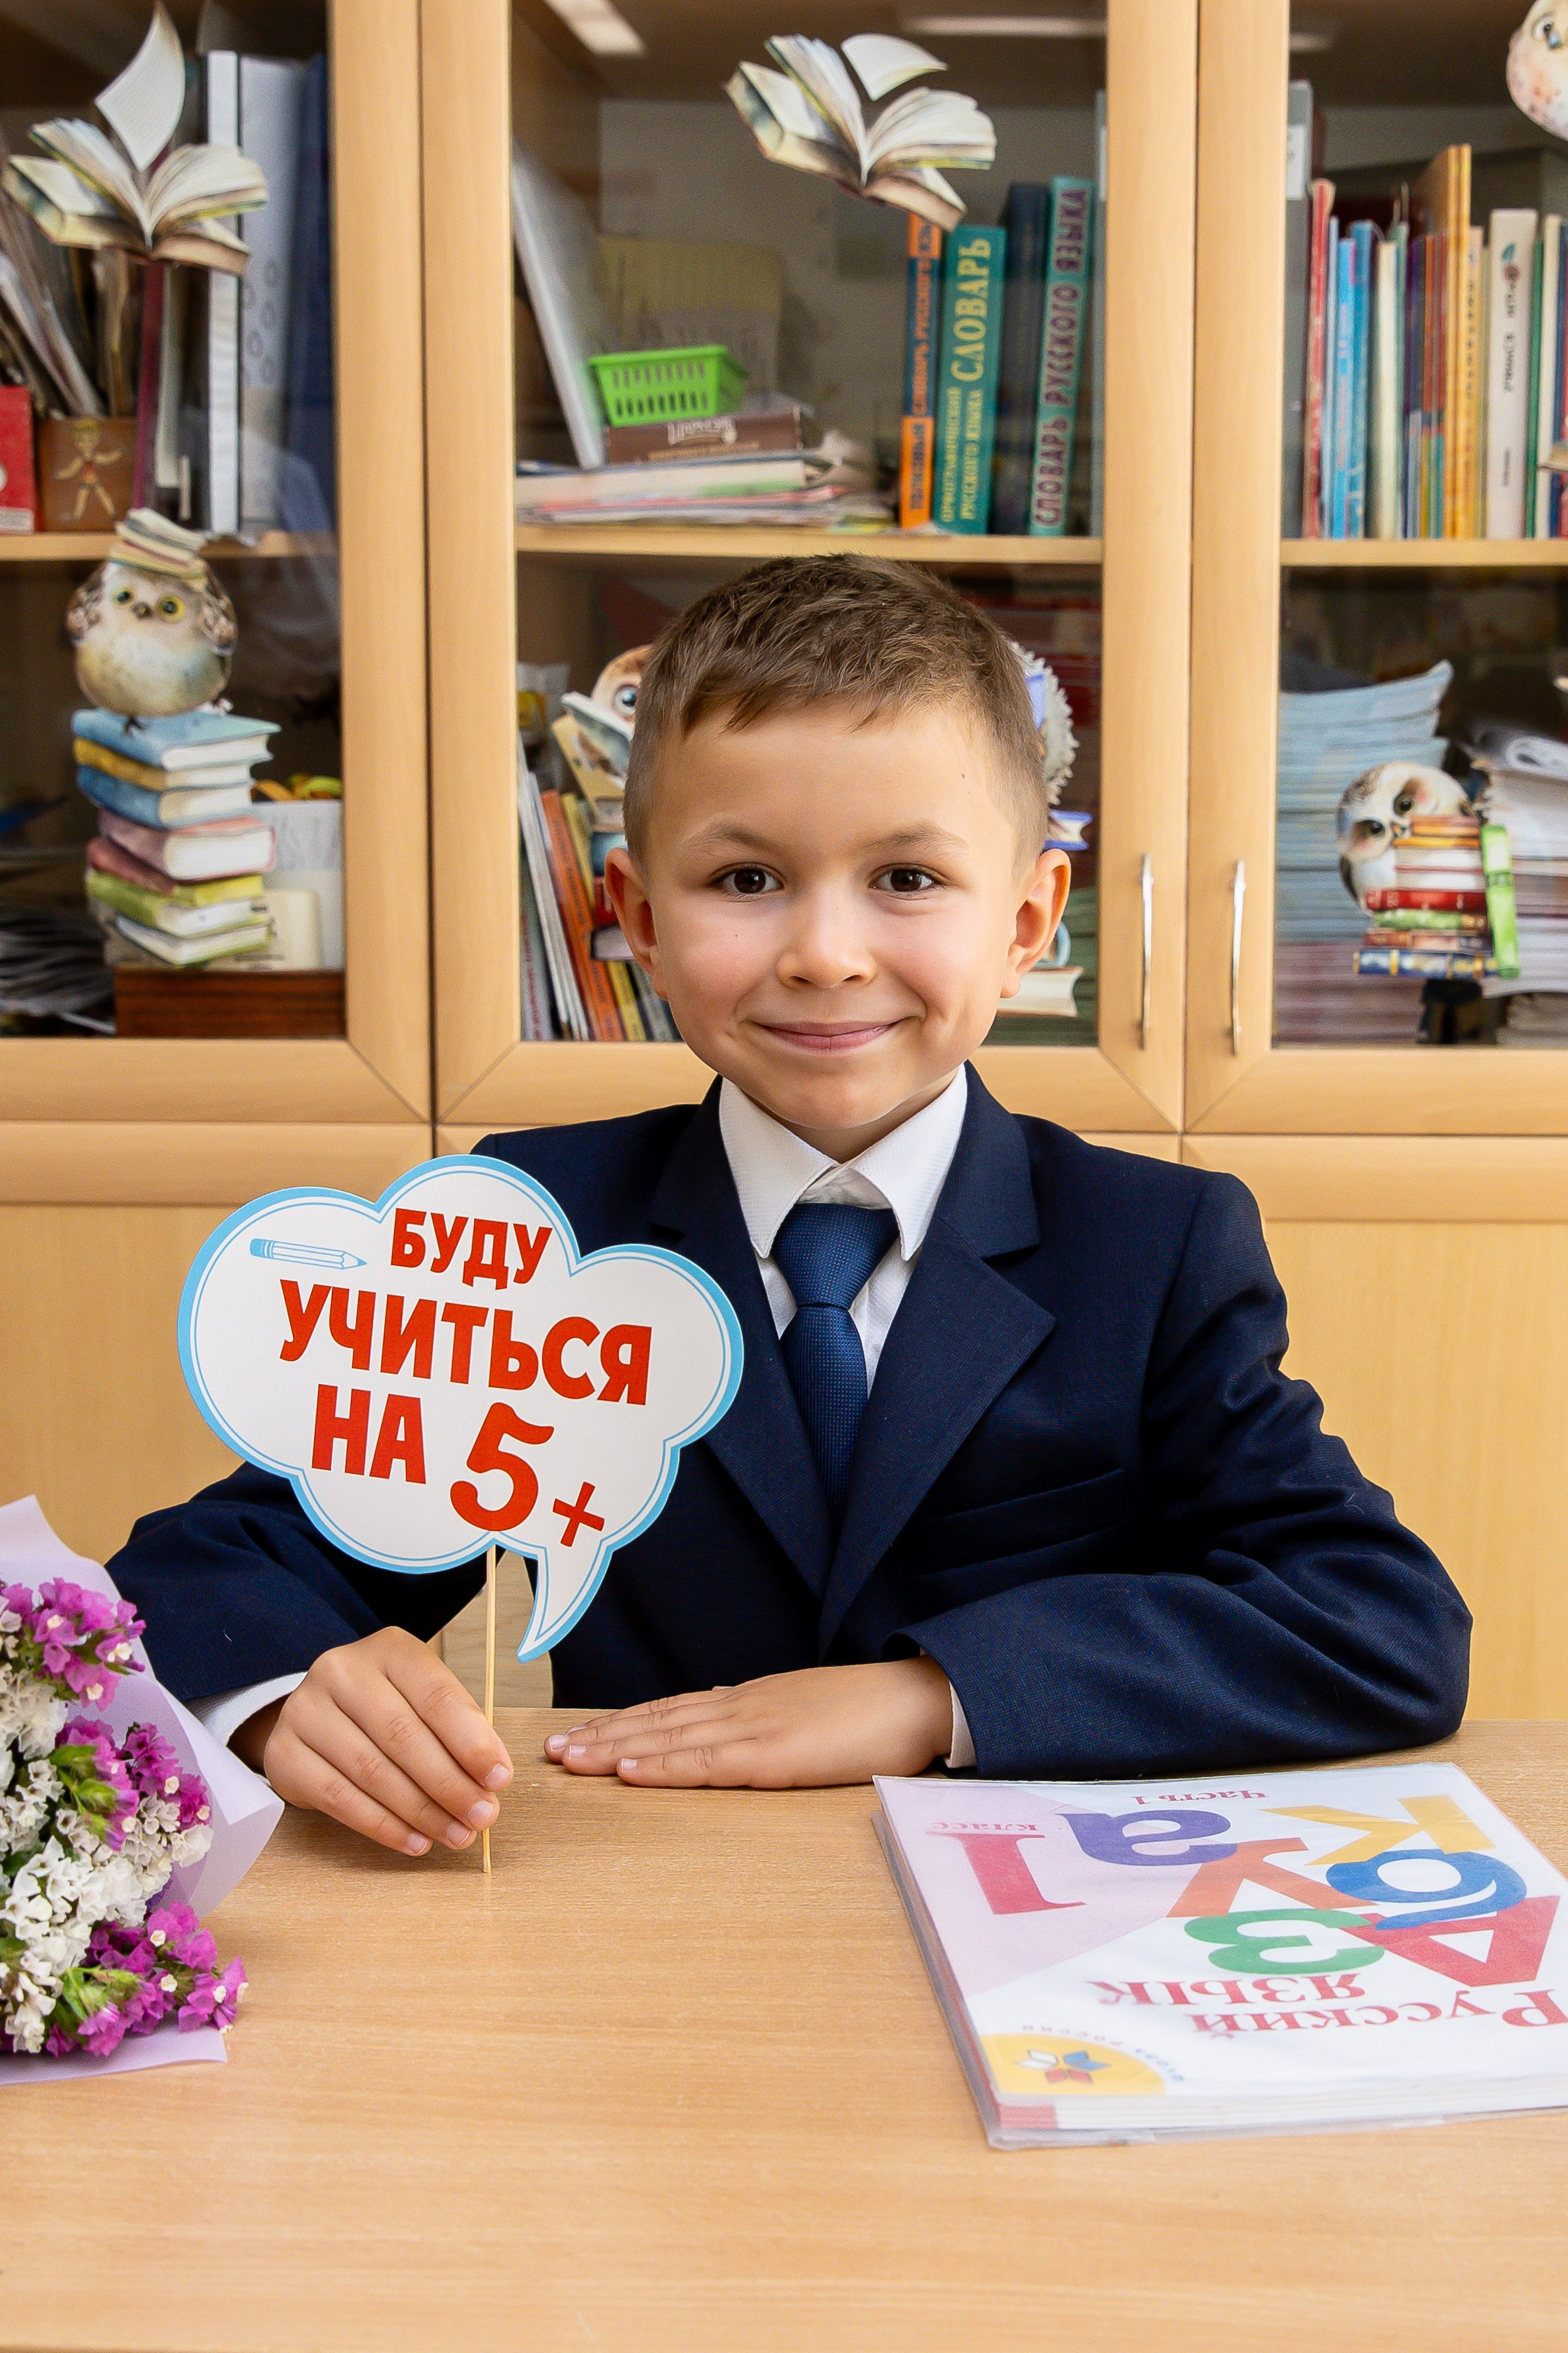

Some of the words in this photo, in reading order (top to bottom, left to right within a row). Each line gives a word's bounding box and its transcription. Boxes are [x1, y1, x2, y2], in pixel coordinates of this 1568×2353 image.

[1054, 188, 1090, 272] ЯЗЫКА
[951, 238, 991, 382] СЛОВАРЬ
[1041, 284, 1081, 407] РУССКОГО
[1034, 417, 1070, 527] СЛОВАРЬ
[390, 1207, 553, 1291] БУДУ
[279, 1279, 653, 1406] УЧИТЬСЯ
[311, 1383, 427, 1485] НА
[932, 1821, 1039, 1832] класс
[1133, 1795, 1152, 1805] 1
[1169, 1790, 1270, 1804] Часть
[926, 1831, 1087, 1915] 1
